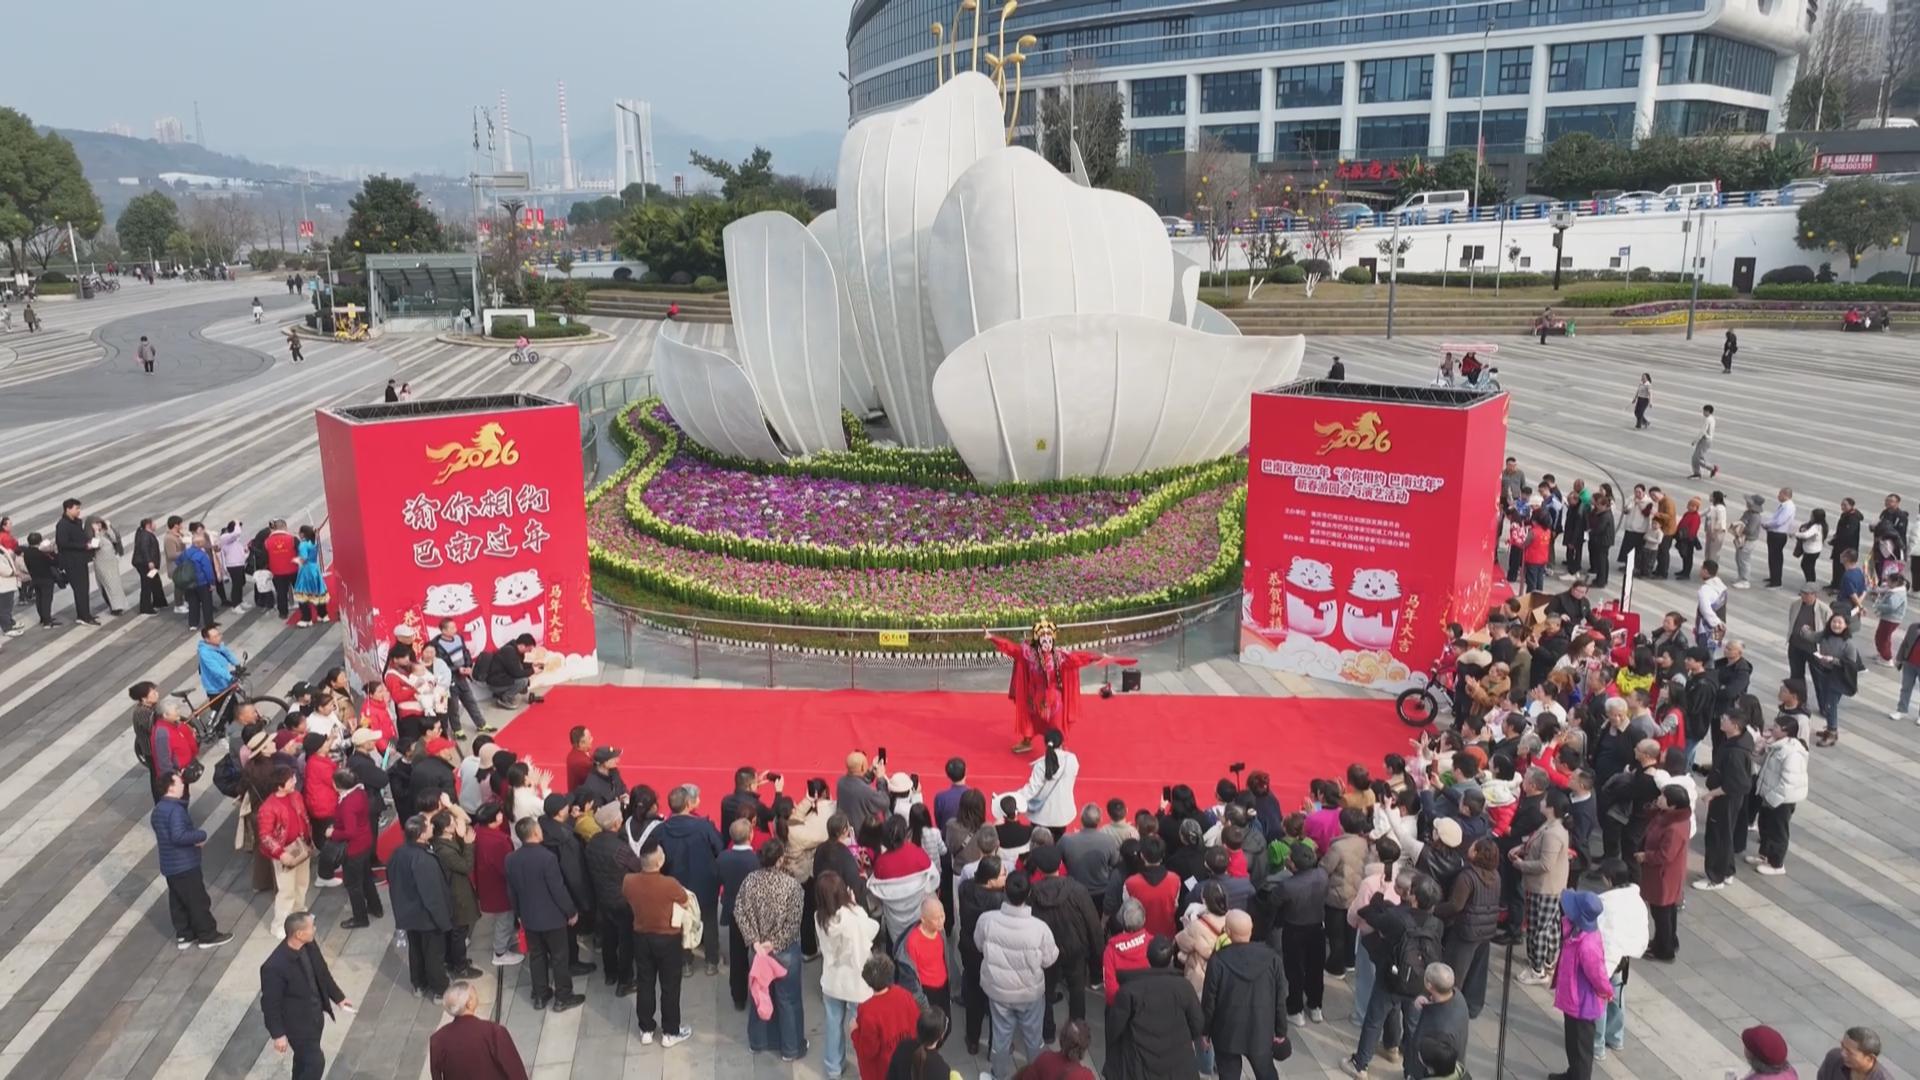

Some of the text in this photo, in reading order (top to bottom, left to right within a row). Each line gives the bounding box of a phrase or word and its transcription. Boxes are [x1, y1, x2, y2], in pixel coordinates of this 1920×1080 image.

[402, 484, 550, 530] 渝你相约
[1295, 477, 1410, 504] 新春游园会与演艺活动
[413, 519, 550, 570] 巴南过年
[548, 584, 564, 644] 马年大吉
[1267, 571, 1283, 631] 恭贺新禧
[1398, 593, 1421, 653] 马年大吉
